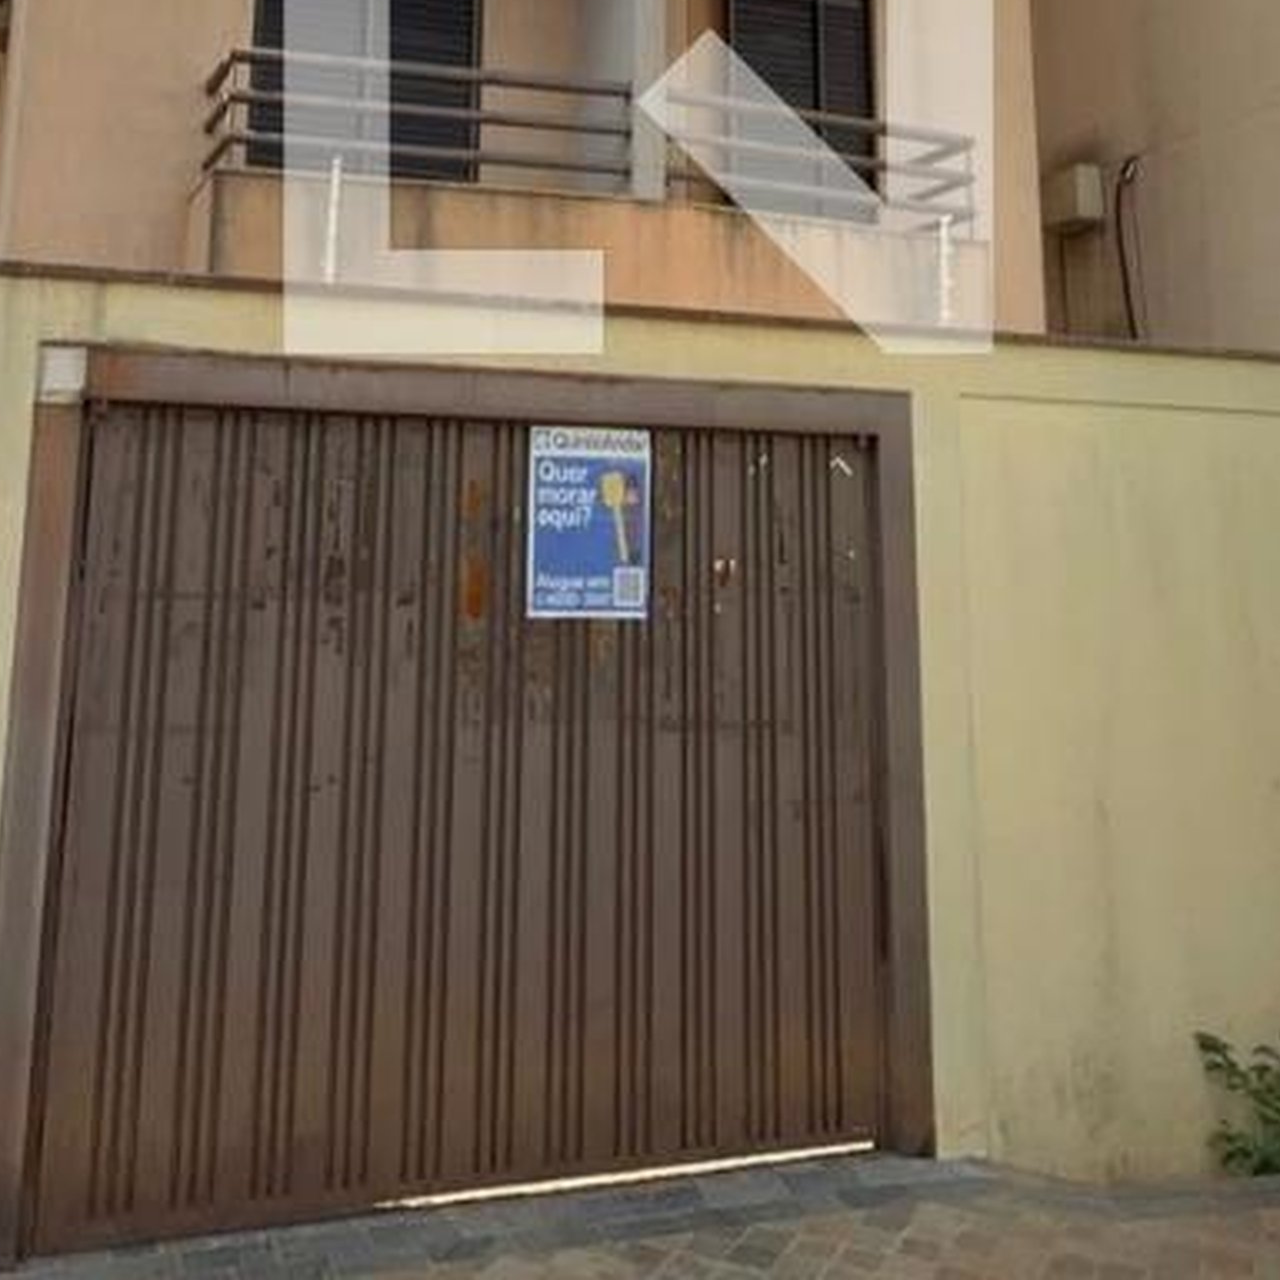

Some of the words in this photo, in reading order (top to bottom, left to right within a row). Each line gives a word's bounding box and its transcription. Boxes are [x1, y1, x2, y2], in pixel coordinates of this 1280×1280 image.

[539, 460, 588, 483] Quer
[538, 486, 597, 506] morar
[538, 506, 592, 532] aqui?
